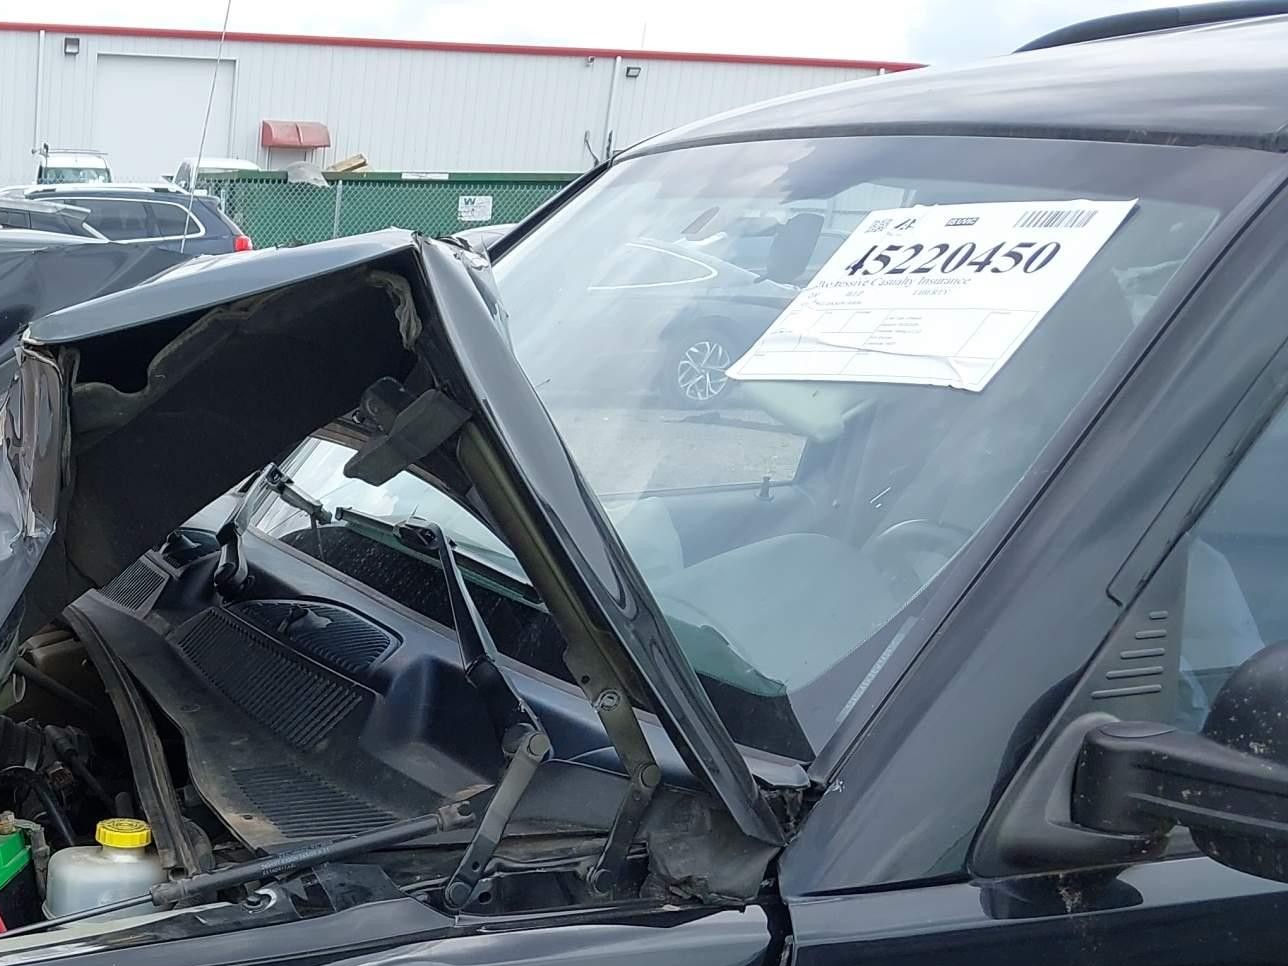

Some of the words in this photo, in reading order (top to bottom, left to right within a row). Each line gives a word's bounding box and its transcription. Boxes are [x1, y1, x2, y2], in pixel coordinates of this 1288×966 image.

[845, 241, 1061, 276] 45220450
[870, 276, 914, 289] Casualty
[918, 275, 972, 286] Insurance
